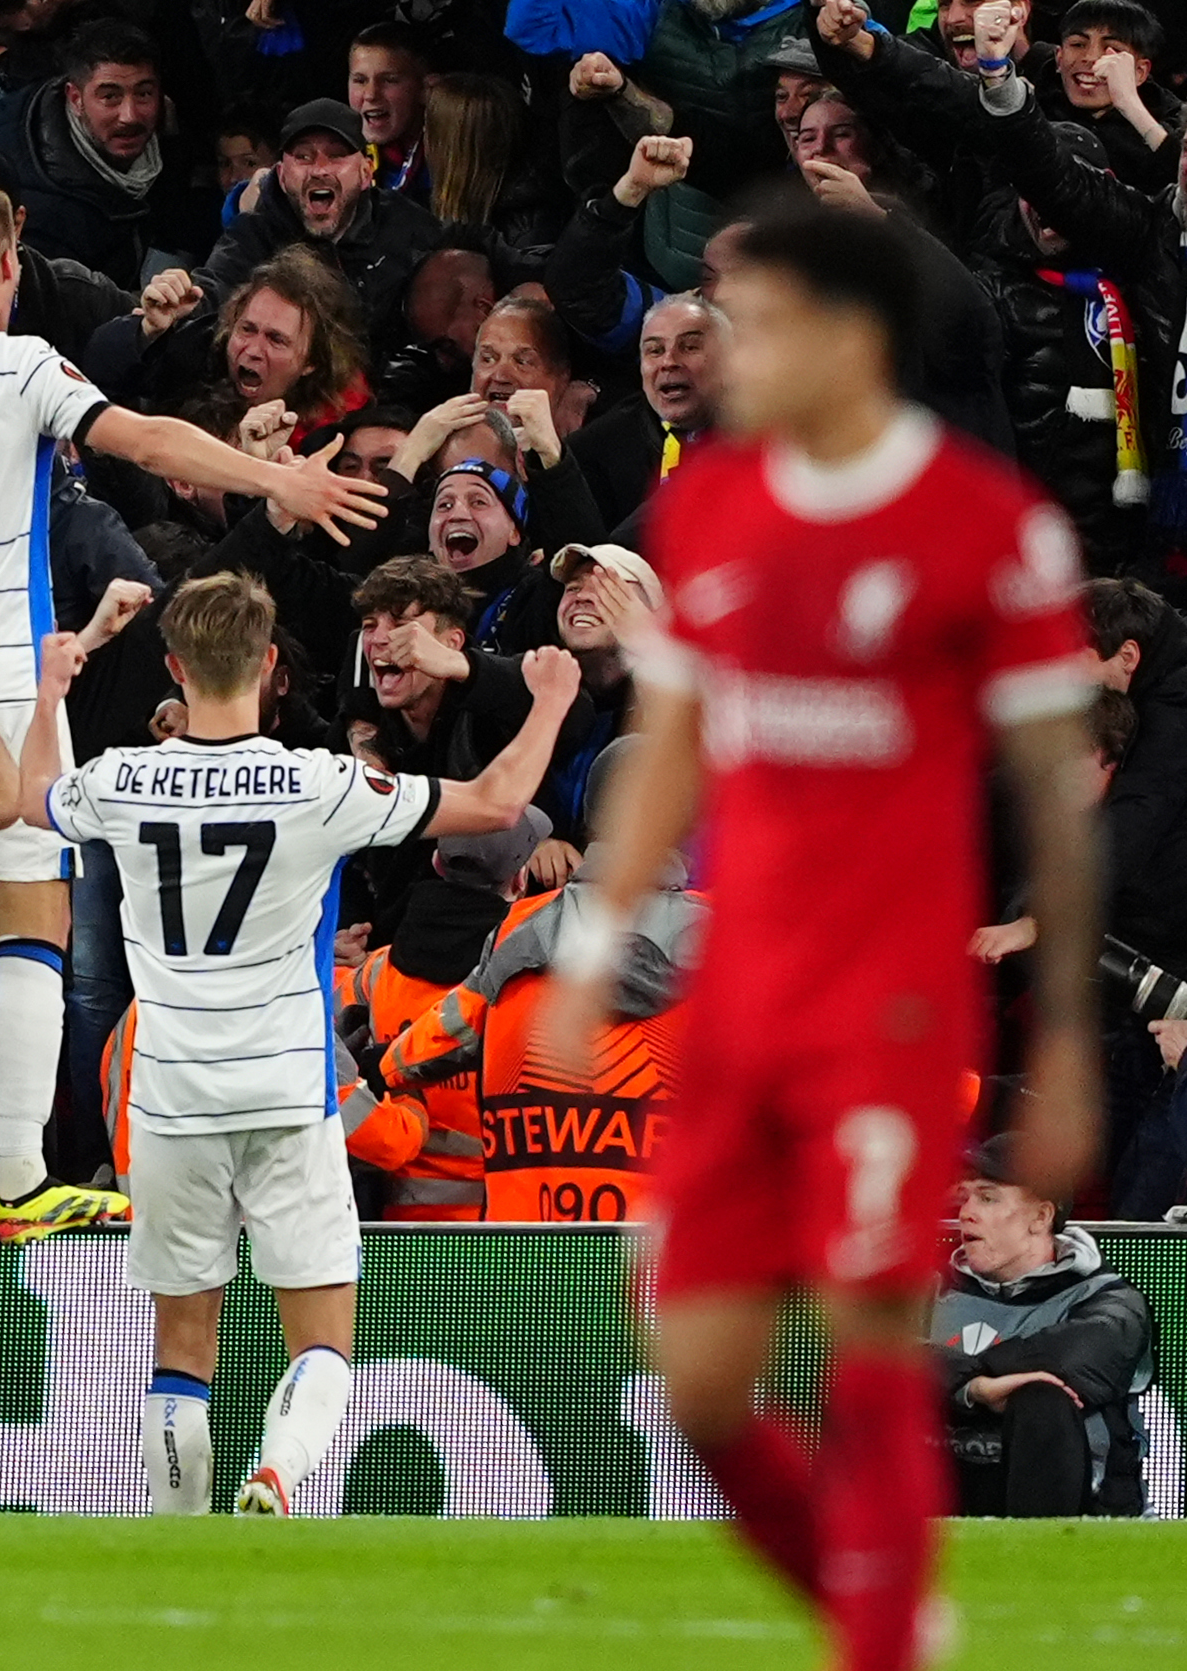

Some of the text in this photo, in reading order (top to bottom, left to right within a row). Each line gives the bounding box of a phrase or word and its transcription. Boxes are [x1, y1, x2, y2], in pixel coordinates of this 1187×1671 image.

[115, 762, 302, 799] DE KETELAERE
[138, 820, 277, 957] 17
